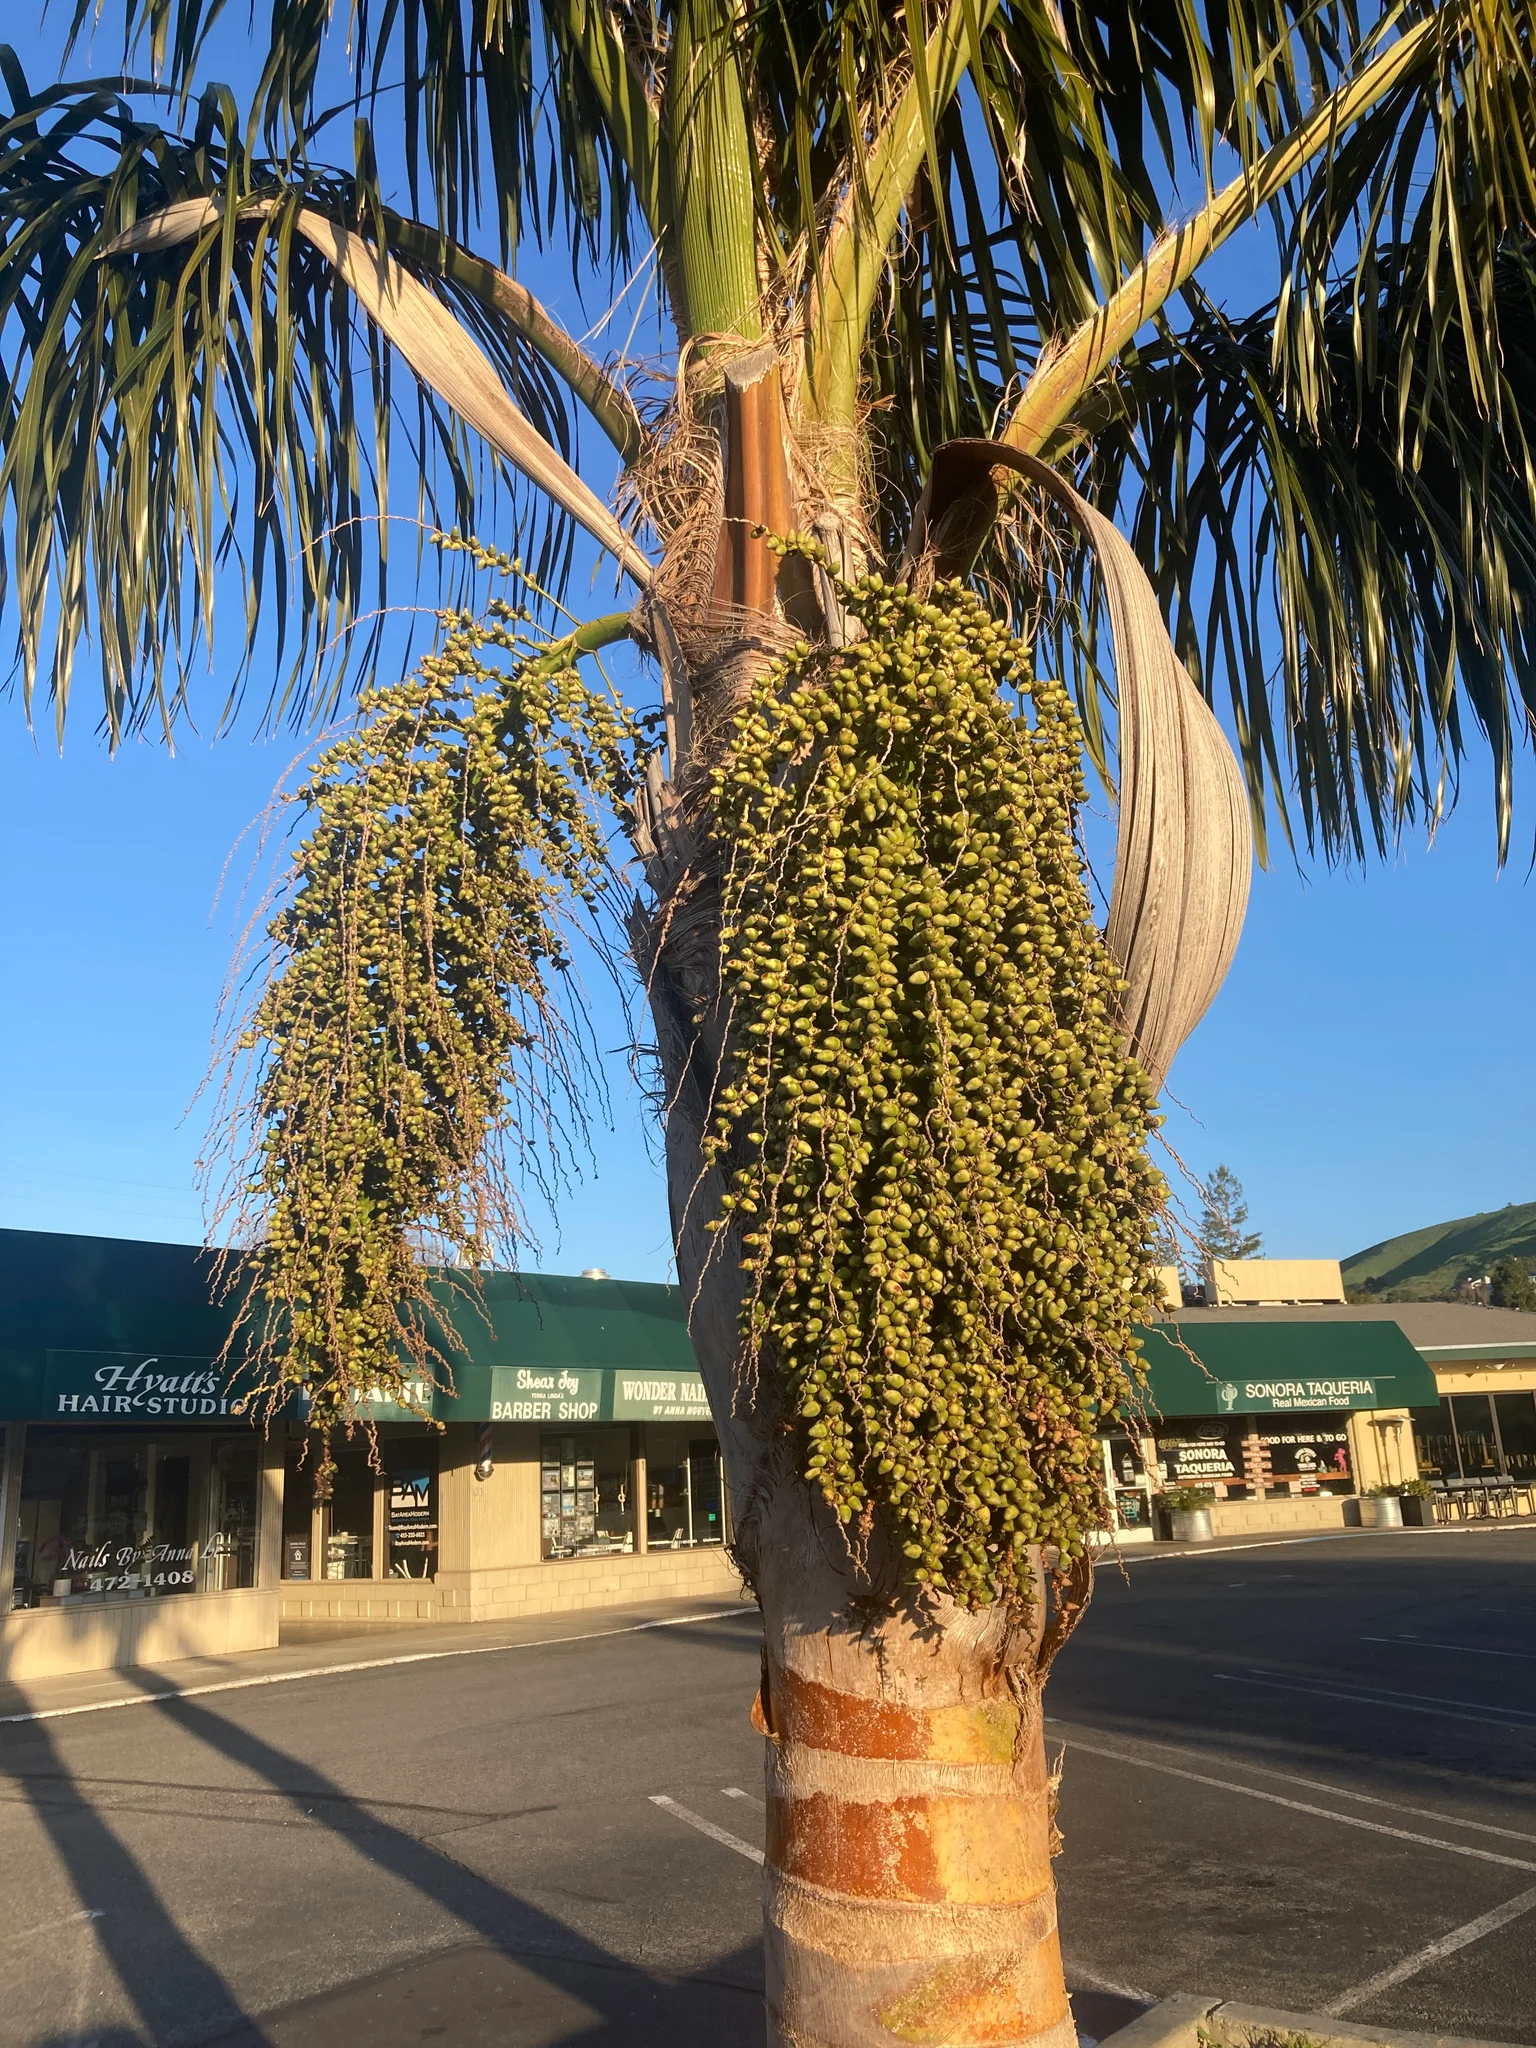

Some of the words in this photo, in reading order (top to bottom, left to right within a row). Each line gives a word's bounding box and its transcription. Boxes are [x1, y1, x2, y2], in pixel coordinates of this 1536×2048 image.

[94, 1357, 220, 1407] Hyatt's
[516, 1369, 555, 1390] Shear
[557, 1369, 580, 1396] Joy
[622, 1380, 677, 1401] WONDER
[1245, 1382, 1304, 1399] SONORA
[1305, 1380, 1374, 1396] TAQUERIA
[57, 1394, 132, 1413] HAIR
[146, 1397, 248, 1416] STUDIO
[492, 1401, 552, 1420] BARBER
[558, 1401, 598, 1420] SHOP
[653, 1405, 664, 1415] BY
[664, 1405, 685, 1416] ANNA
[1272, 1398, 1293, 1408] Real
[1293, 1397, 1328, 1407] Mexican
[1328, 1395, 1350, 1406] Food
[1281, 1435, 1296, 1444] FOR
[1297, 1434, 1315, 1443] HERE
[1316, 1434, 1323, 1442] &
[1324, 1433, 1335, 1442] TO
[1335, 1433, 1347, 1442] GO
[1178, 1448, 1228, 1462] SONORA
[1173, 1461, 1236, 1475] TAQUERIA
[61, 1541, 112, 1571] Nails
[149, 1543, 195, 1563] Anna
[90, 1570, 194, 1592] 472-1408
